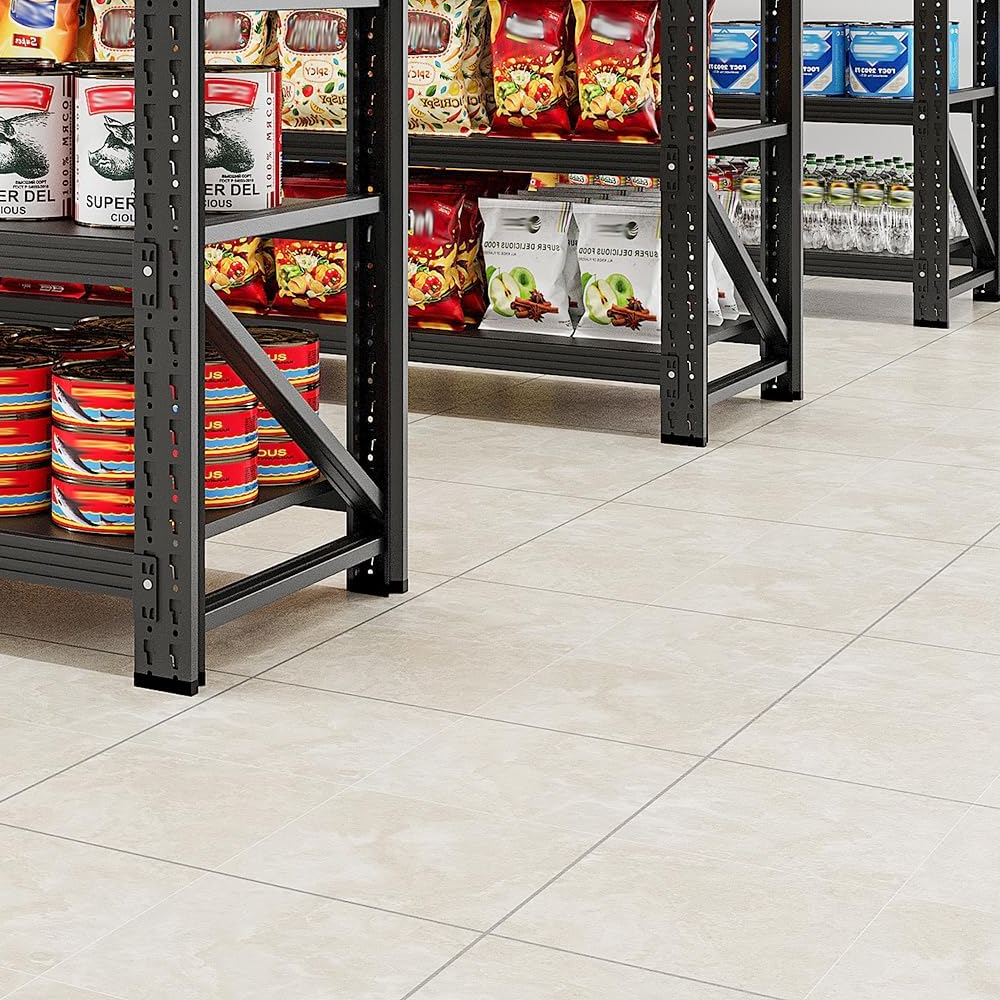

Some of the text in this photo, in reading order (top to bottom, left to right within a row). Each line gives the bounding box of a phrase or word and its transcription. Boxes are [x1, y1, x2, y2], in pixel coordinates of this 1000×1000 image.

[24, 189, 56, 202] DEL
[230, 183, 260, 196] DEL
[86, 194, 134, 210] SUPER
[204, 199, 233, 208] IOUS
[110, 213, 134, 222] CIOU
